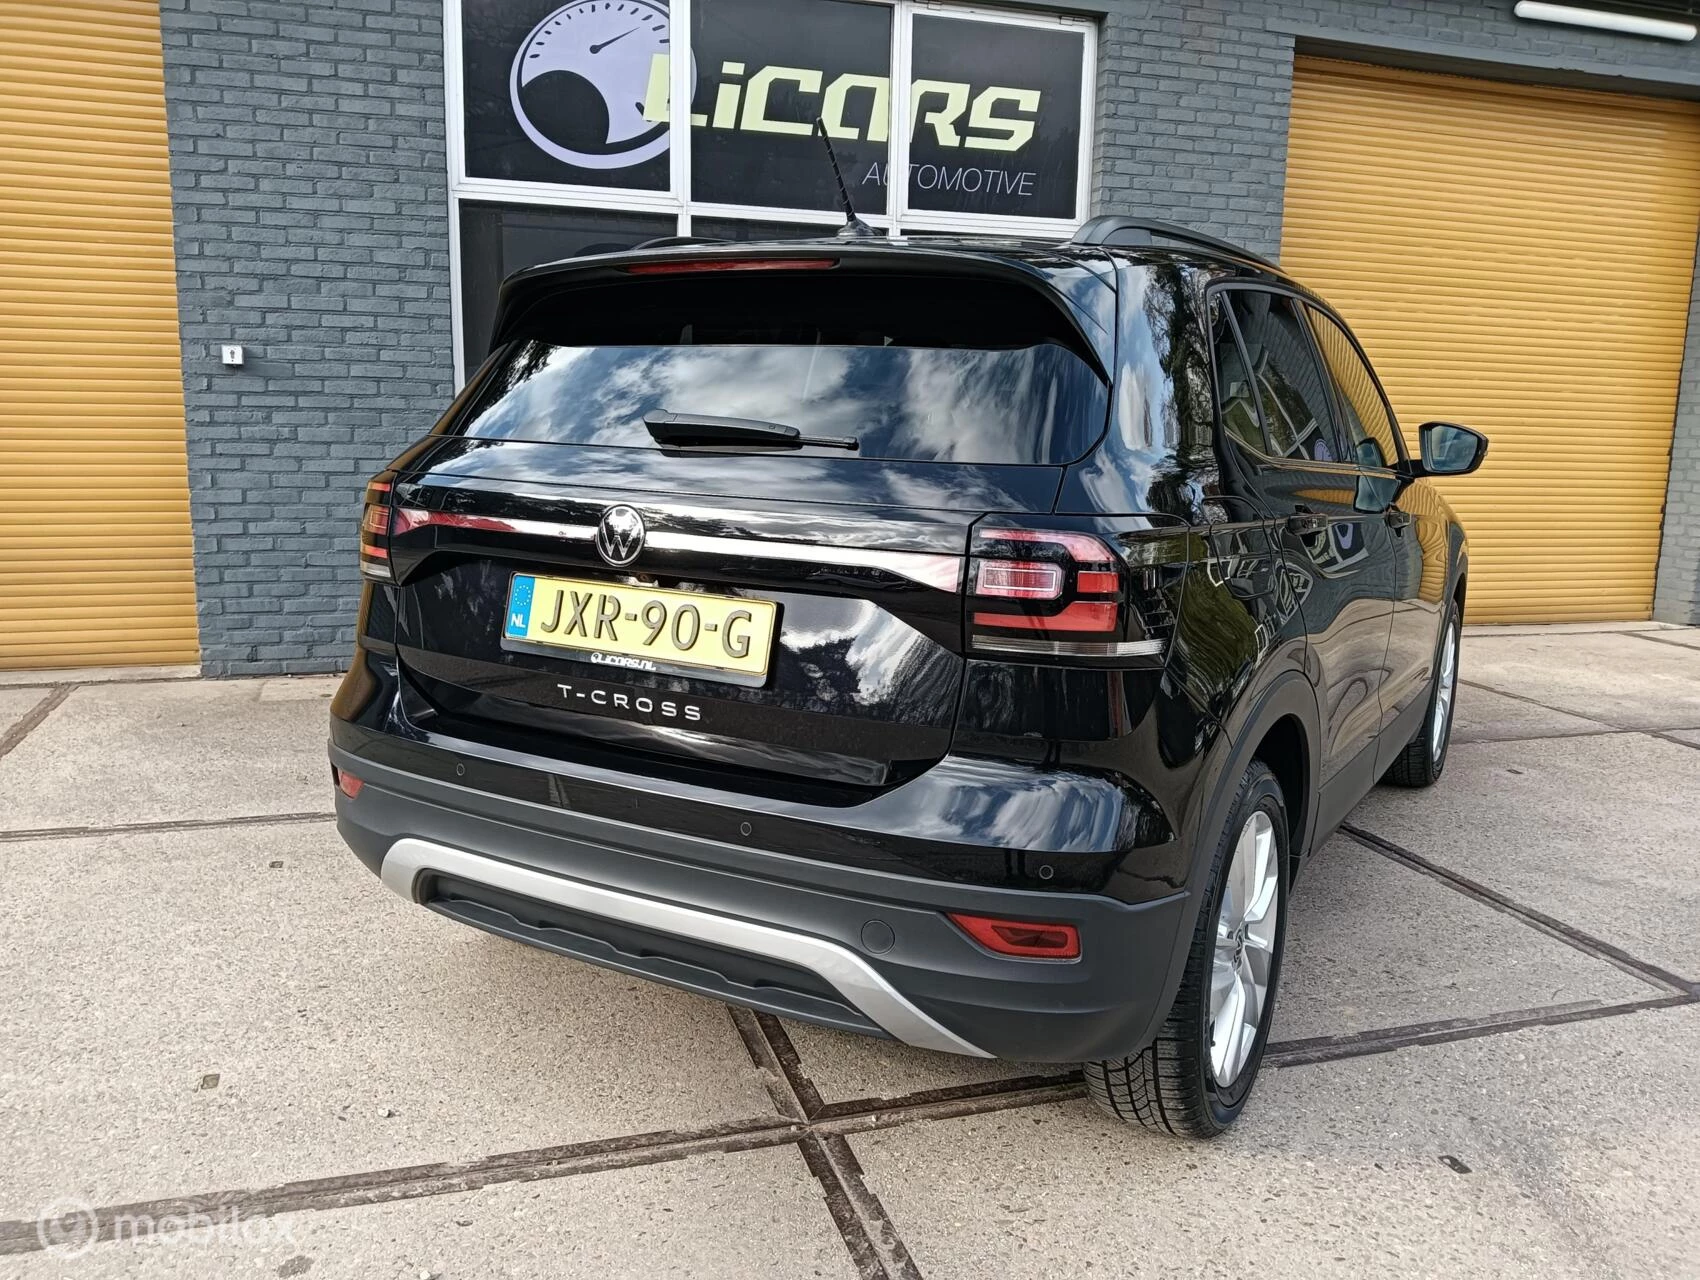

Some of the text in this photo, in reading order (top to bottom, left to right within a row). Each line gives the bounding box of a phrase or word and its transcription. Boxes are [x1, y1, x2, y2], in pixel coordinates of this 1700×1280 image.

[600, 508, 642, 561] W
[510, 613, 526, 629] NL
[540, 589, 753, 658] JXR-90-G
[557, 683, 701, 721] T-CROSS
